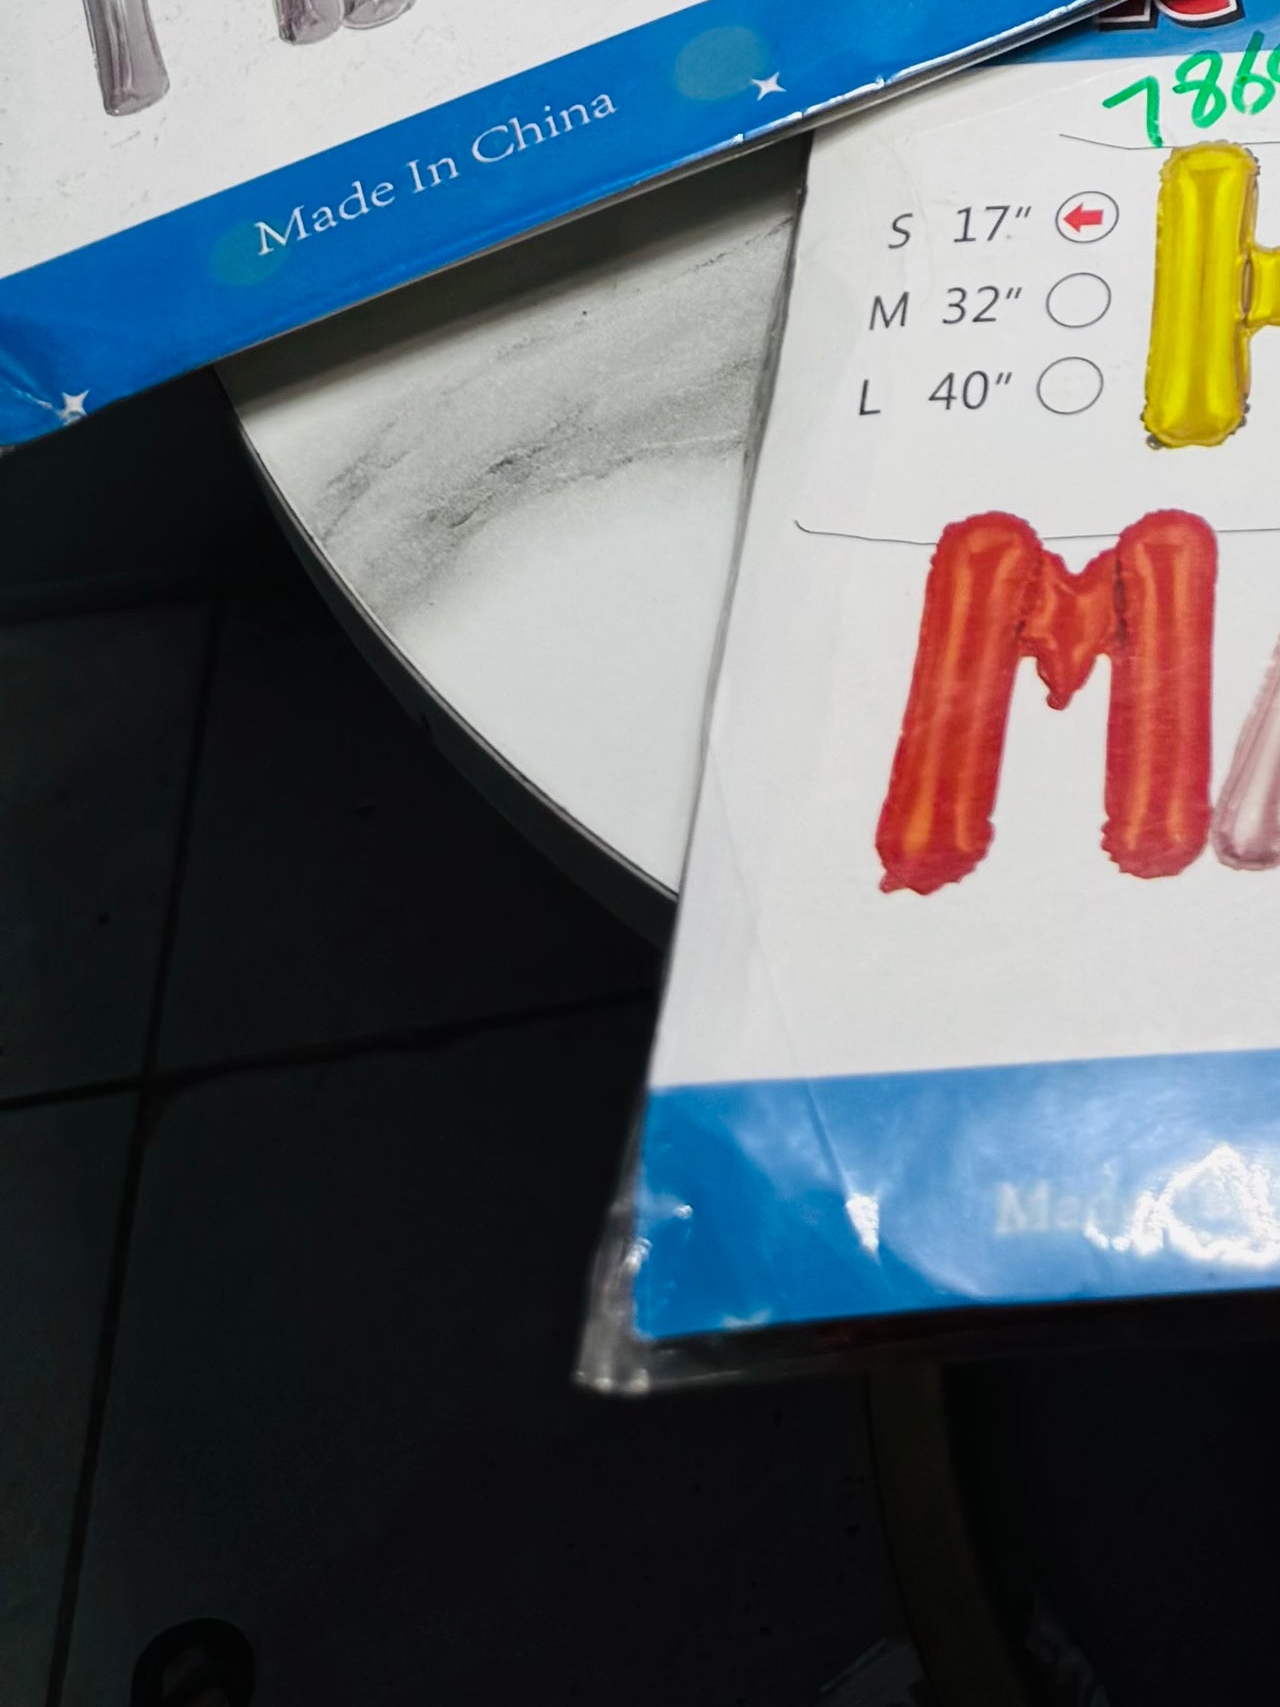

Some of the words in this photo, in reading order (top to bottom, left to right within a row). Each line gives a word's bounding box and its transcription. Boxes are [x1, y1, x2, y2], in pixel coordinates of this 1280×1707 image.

[254, 181, 396, 256] Made
[406, 156, 459, 194] In
[471, 93, 618, 163] China
[888, 212, 913, 249] S
[869, 292, 909, 330] M
[859, 379, 881, 415] L
